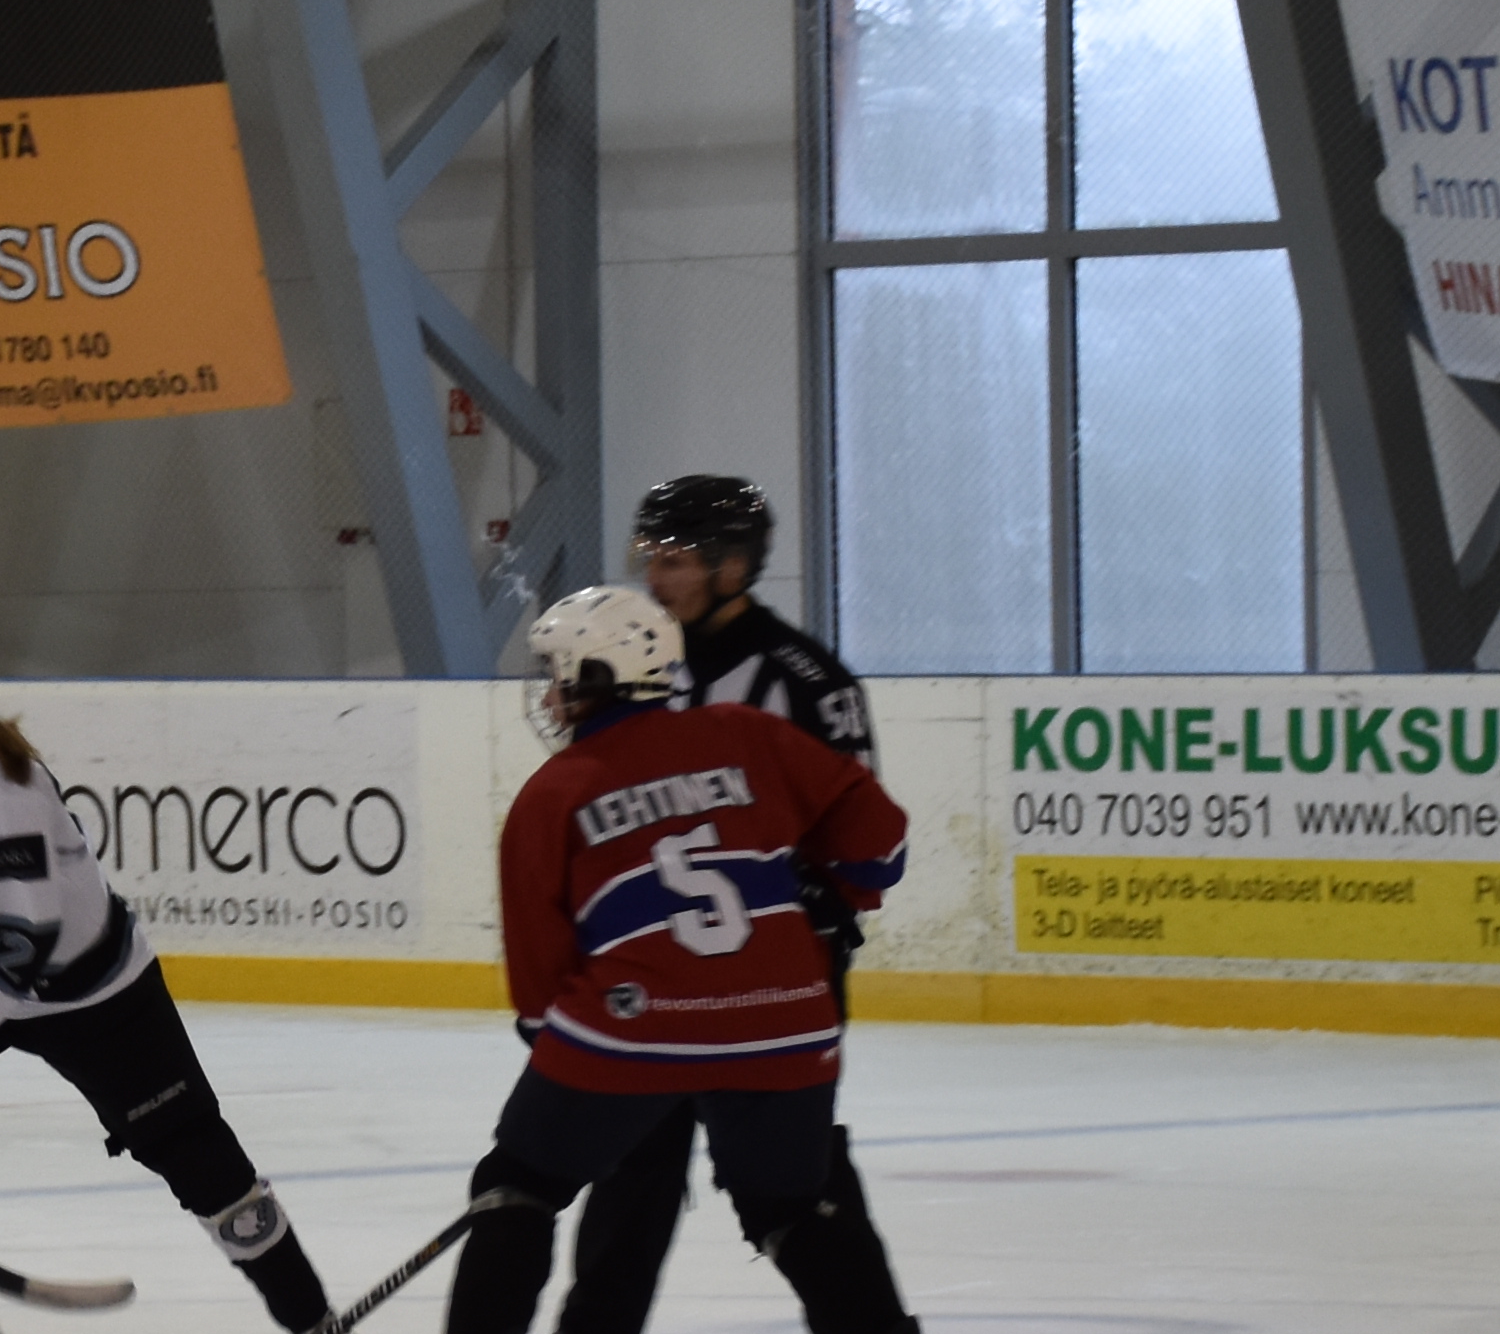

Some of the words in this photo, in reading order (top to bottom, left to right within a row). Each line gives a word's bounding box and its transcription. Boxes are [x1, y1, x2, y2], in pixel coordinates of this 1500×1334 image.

[60, 332, 110, 359] 140
[575, 766, 755, 847] LEHTINEN
[1014, 791, 1084, 837] 040
[1097, 792, 1190, 838] 7039
[1202, 794, 1271, 839] 951
[651, 821, 755, 956] 5
[1097, 871, 1119, 905] ja
